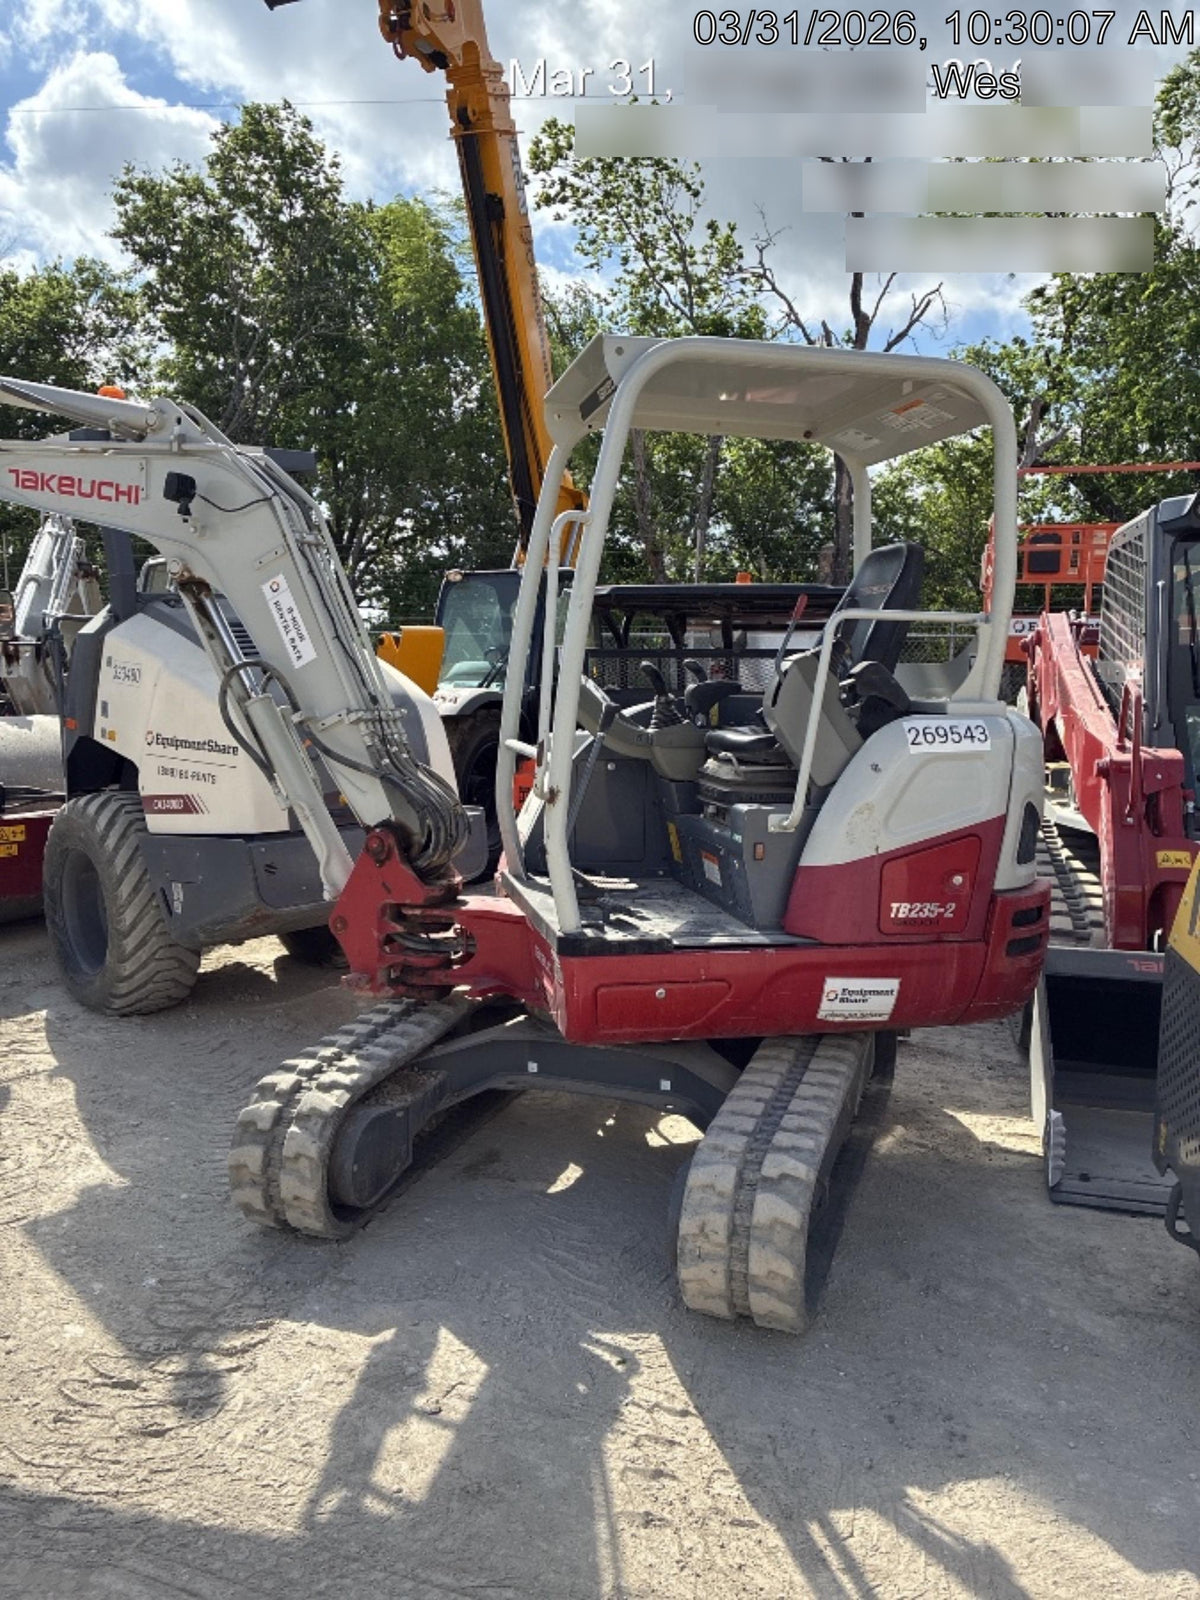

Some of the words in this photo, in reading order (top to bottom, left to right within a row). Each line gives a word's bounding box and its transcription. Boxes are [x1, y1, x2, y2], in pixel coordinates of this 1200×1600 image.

[907, 724, 989, 746] 269543
[155, 732, 240, 757] EquipmentShare
[890, 902, 957, 918] TB235-2
[838, 996, 869, 1004] Share
[840, 987, 896, 998] Equipment
